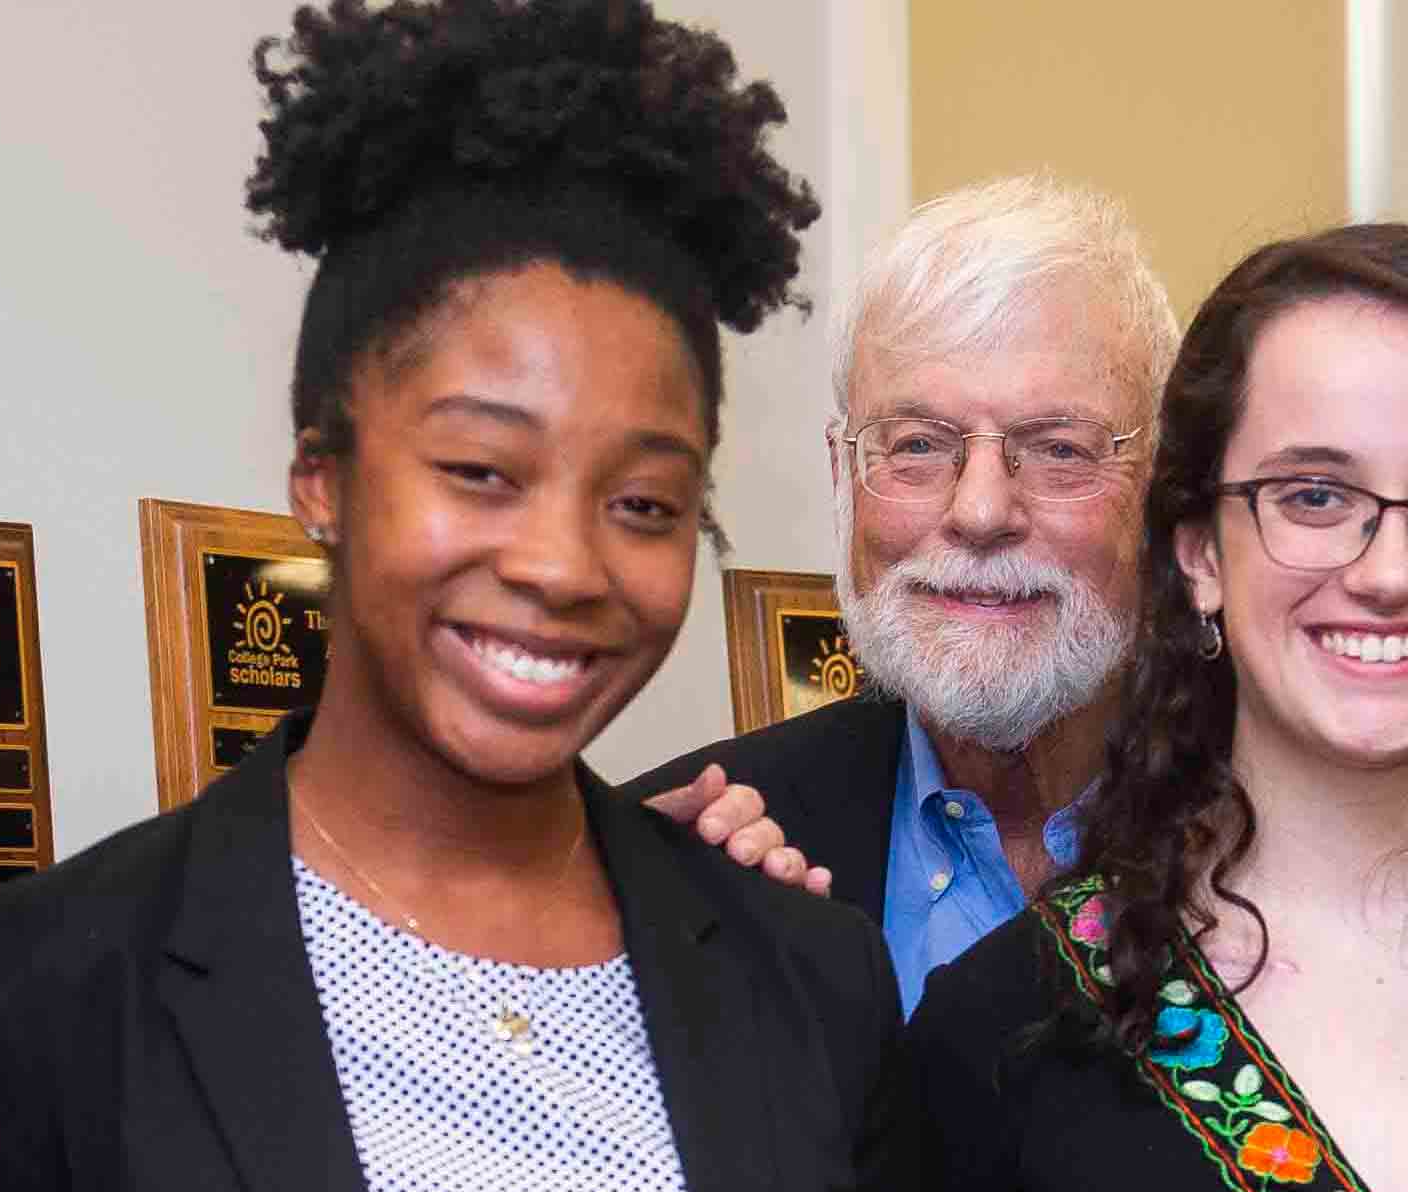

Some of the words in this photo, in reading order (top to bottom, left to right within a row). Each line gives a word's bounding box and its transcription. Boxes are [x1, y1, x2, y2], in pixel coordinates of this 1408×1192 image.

[227, 649, 271, 669] College
[272, 653, 300, 669] Park
[229, 665, 302, 689] scholars
